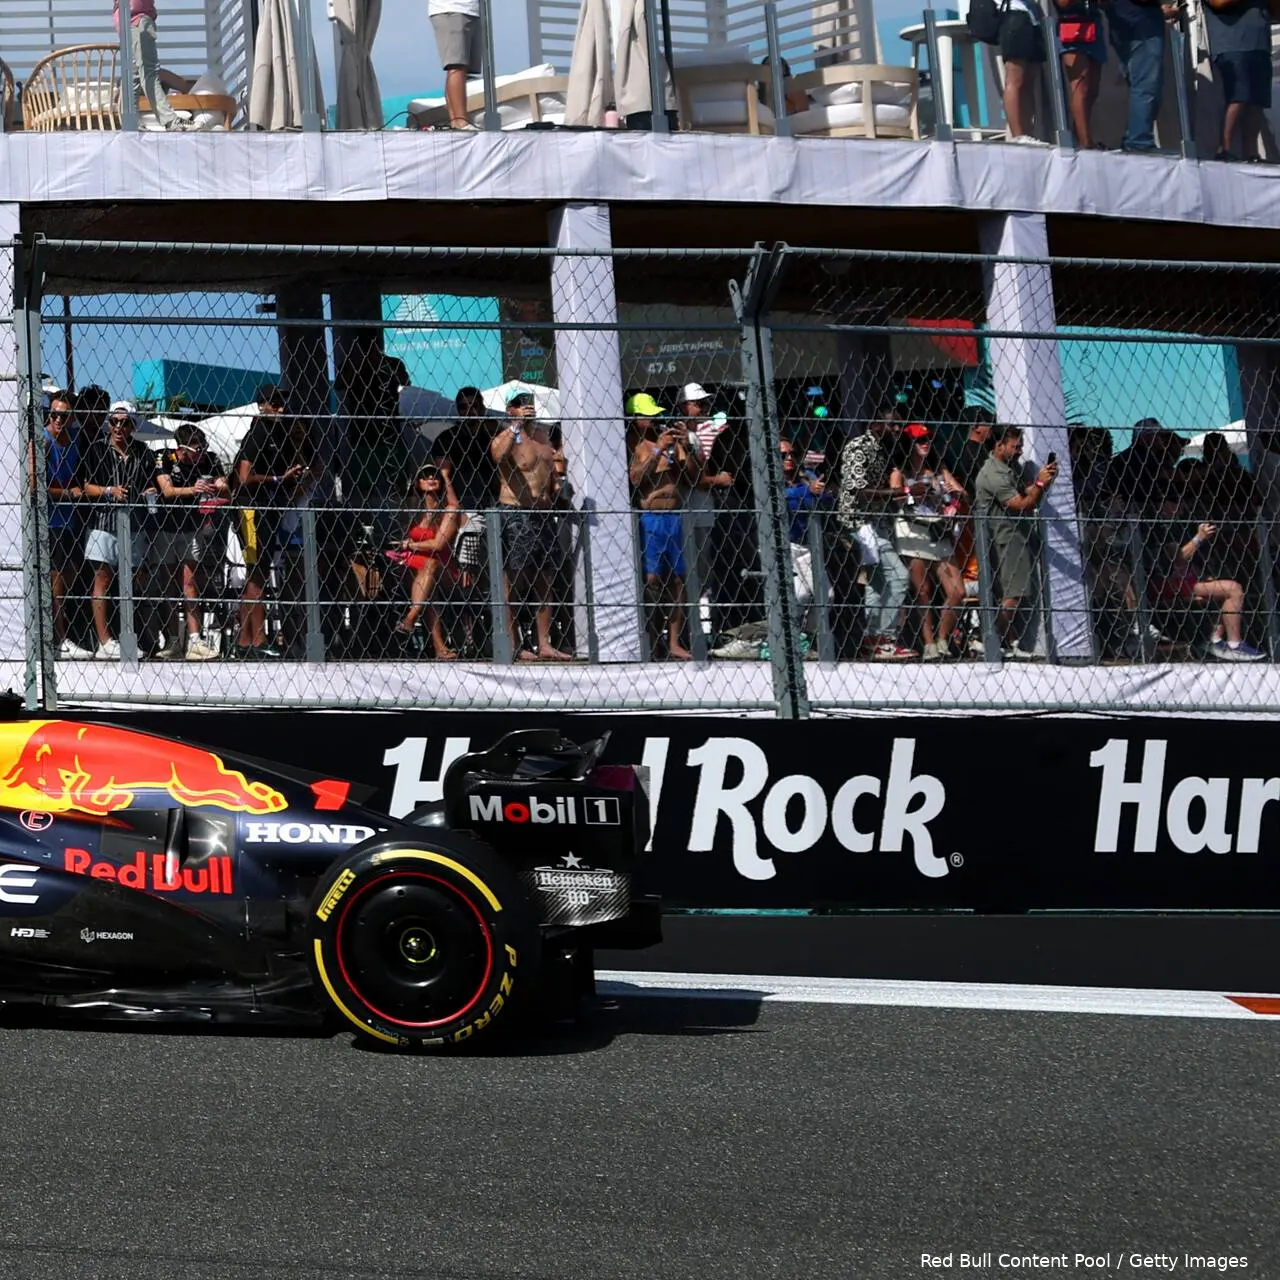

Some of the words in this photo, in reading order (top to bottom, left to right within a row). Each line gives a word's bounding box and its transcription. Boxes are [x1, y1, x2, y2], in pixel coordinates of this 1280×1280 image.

[468, 795, 577, 824] Mobil
[593, 799, 607, 823] 1
[687, 737, 950, 880] Rock
[245, 822, 387, 844] HOND
[63, 848, 146, 891] Red
[152, 854, 233, 894] Bull
[539, 872, 613, 887] Heineken
[316, 868, 357, 922] PIRELLI
[96, 932, 134, 940] HEXAGON
[504, 943, 517, 967] P
[455, 972, 514, 1043] ZERO
